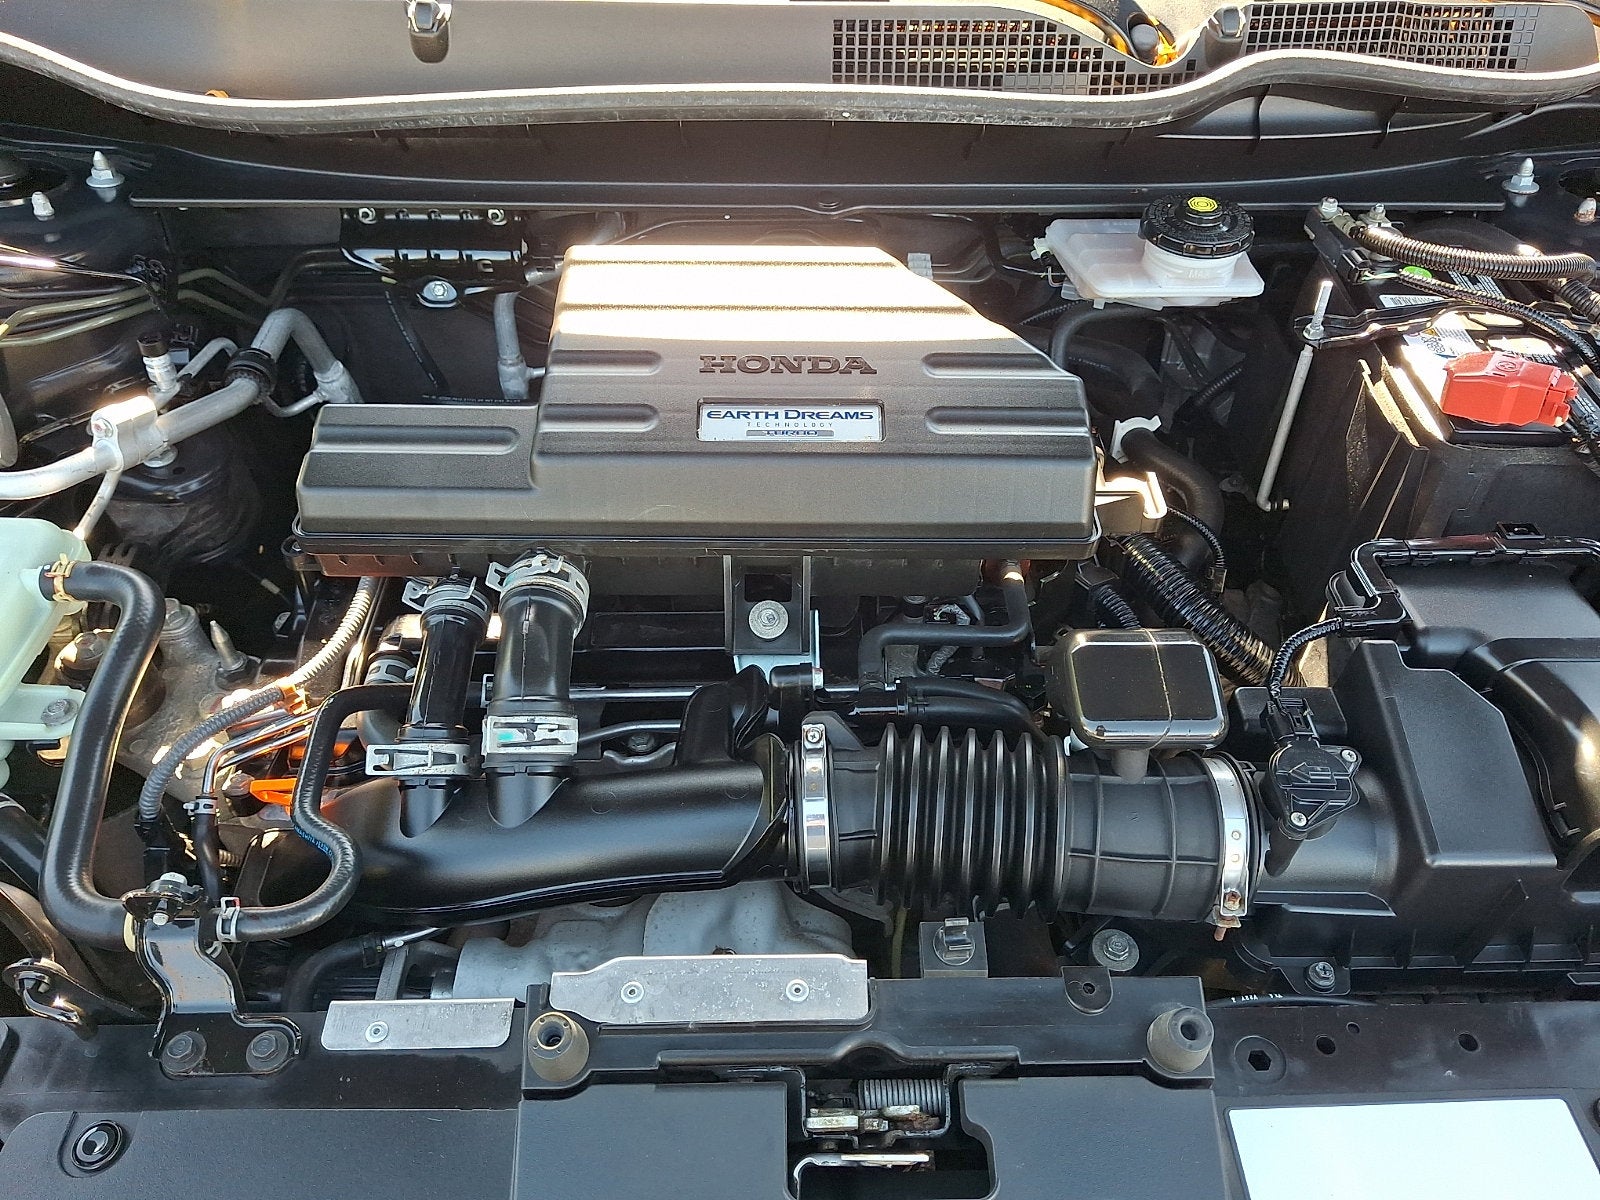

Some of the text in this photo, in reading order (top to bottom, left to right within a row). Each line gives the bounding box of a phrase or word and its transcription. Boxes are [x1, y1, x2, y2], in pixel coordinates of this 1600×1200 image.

[699, 355, 878, 375] HONDA
[706, 409, 874, 420] EARTH DREAMS
